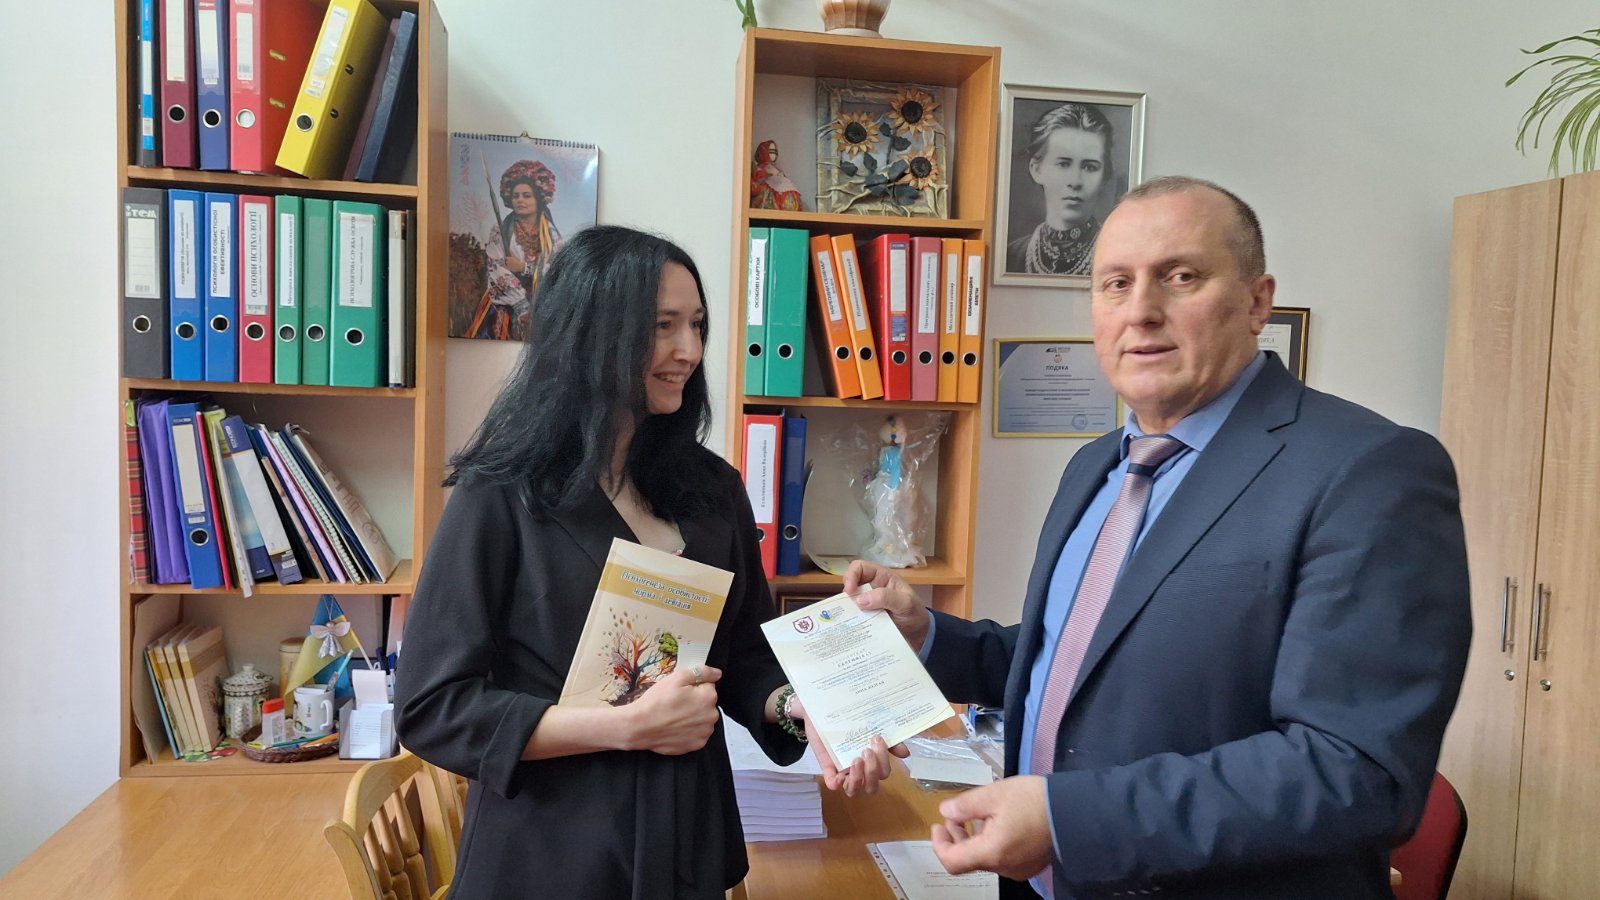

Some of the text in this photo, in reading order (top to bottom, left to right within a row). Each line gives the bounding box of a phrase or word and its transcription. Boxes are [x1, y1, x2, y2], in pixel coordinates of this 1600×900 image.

[249, 210, 258, 298] ОСНОВИ ПСИХОЛОГІЇ
[622, 571, 664, 590] Психогенеза
[633, 587, 656, 600] норма
